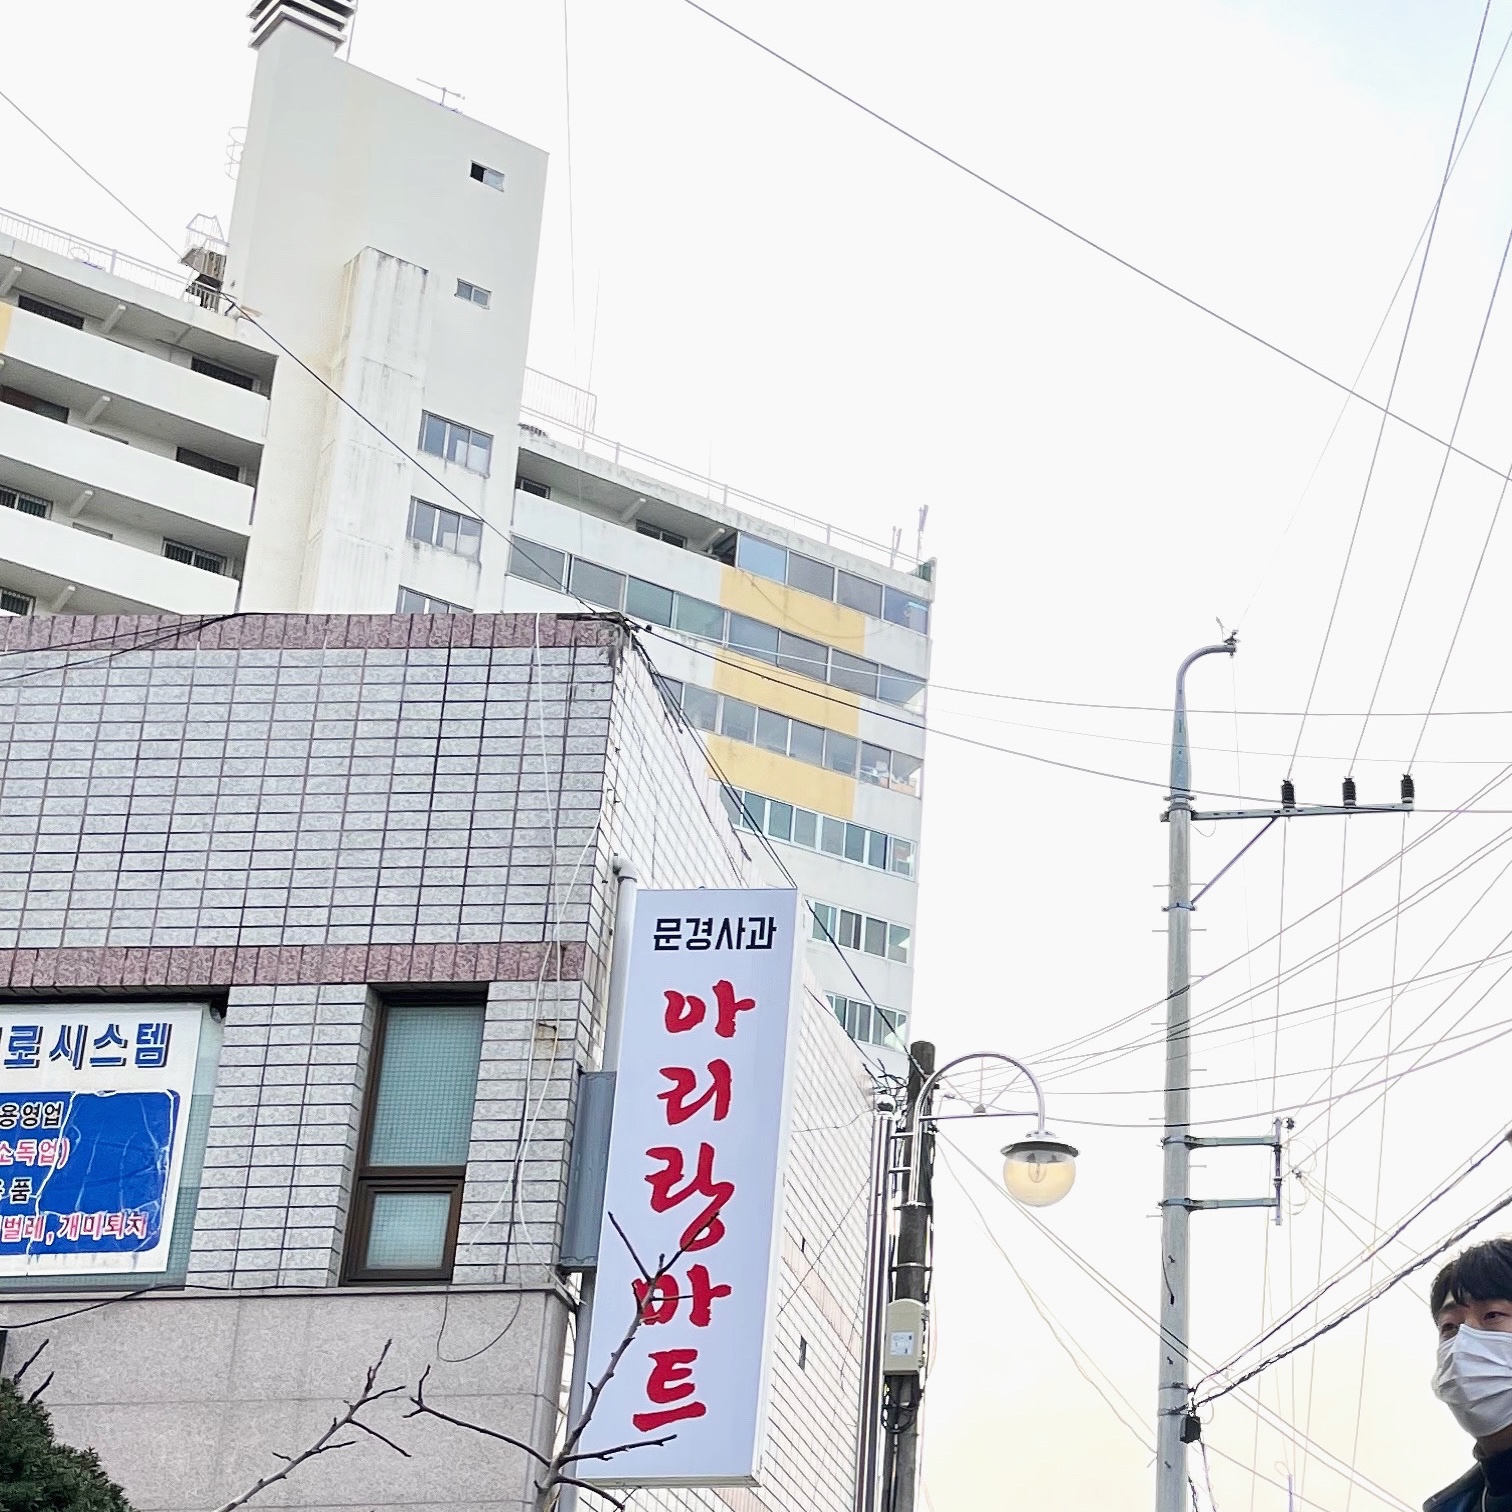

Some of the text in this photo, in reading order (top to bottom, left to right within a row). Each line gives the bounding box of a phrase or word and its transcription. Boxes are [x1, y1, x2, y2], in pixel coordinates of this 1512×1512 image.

[653, 916, 777, 951] 문경사과
[0, 1022, 173, 1070] 로시스템
[632, 979, 756, 1432] 아리랑마트
[0, 1212, 148, 1244] 벌레,개미퇴치
